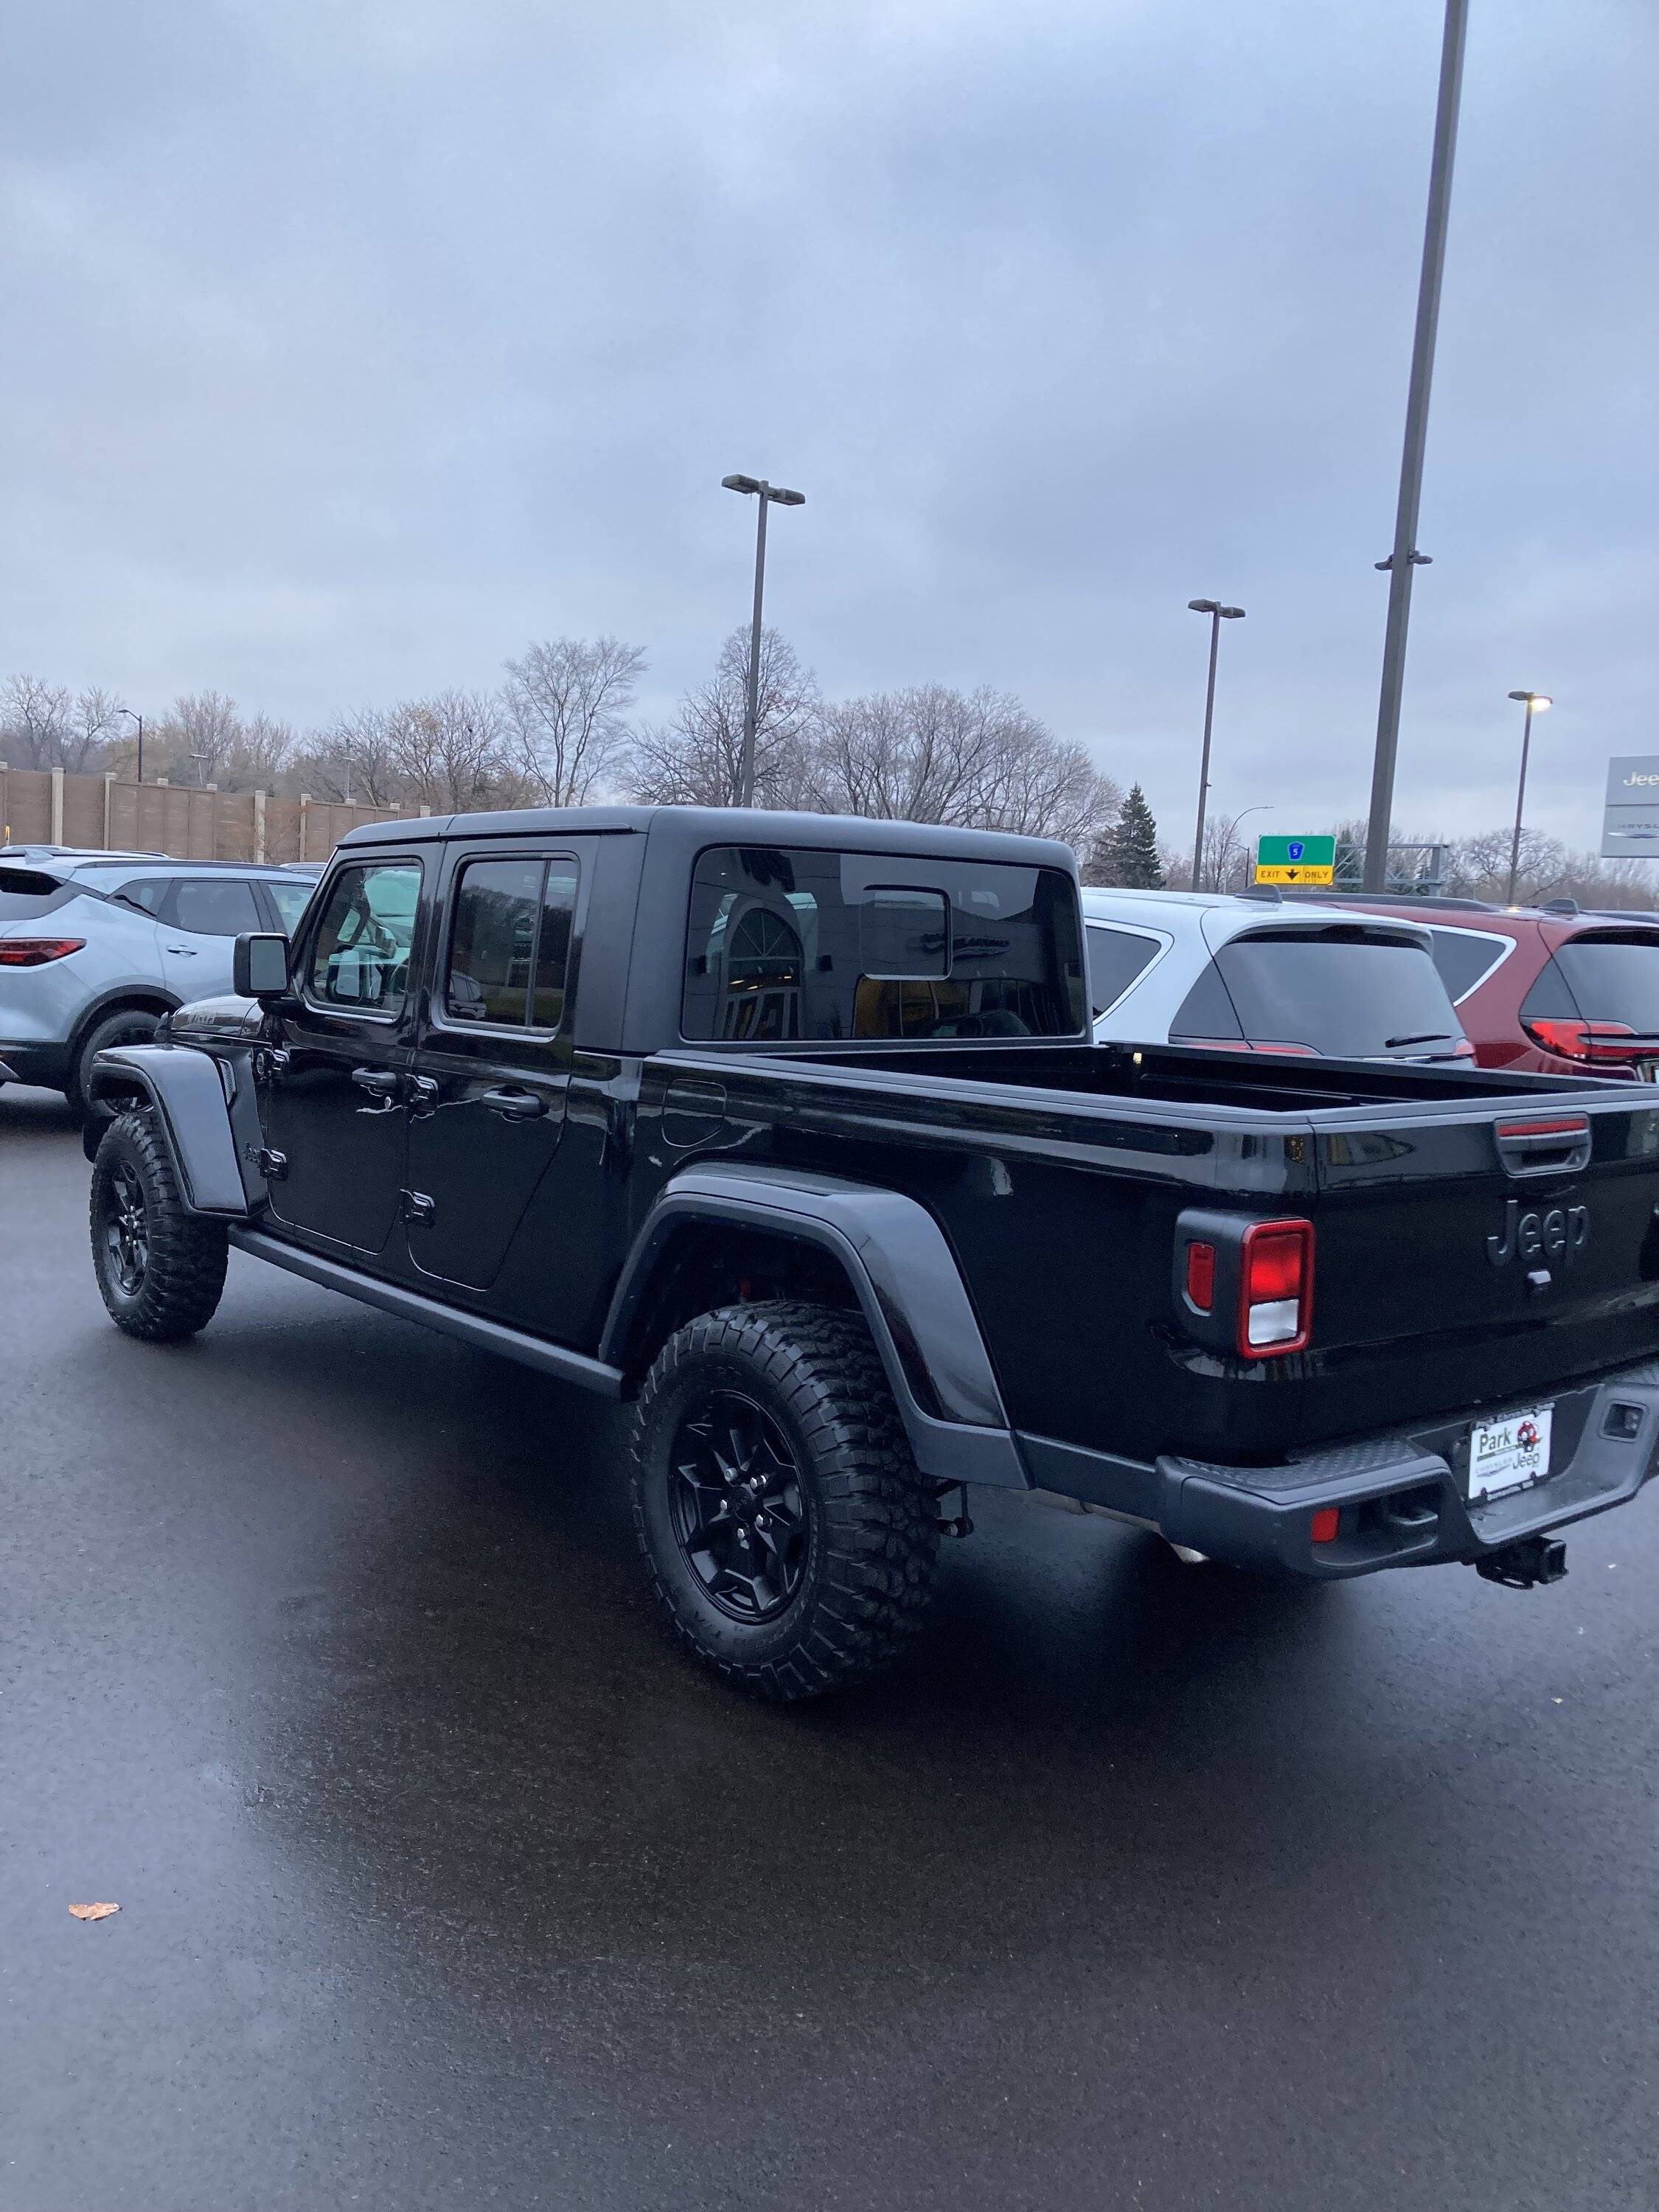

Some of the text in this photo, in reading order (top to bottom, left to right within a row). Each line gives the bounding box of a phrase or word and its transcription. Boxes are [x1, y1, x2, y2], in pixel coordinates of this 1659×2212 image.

[1293, 848, 1298, 856] 5
[1486, 1200, 1588, 1267] Jeep
[1480, 1427, 1512, 1453] Park
[1512, 1451, 1540, 1470] Jeep
